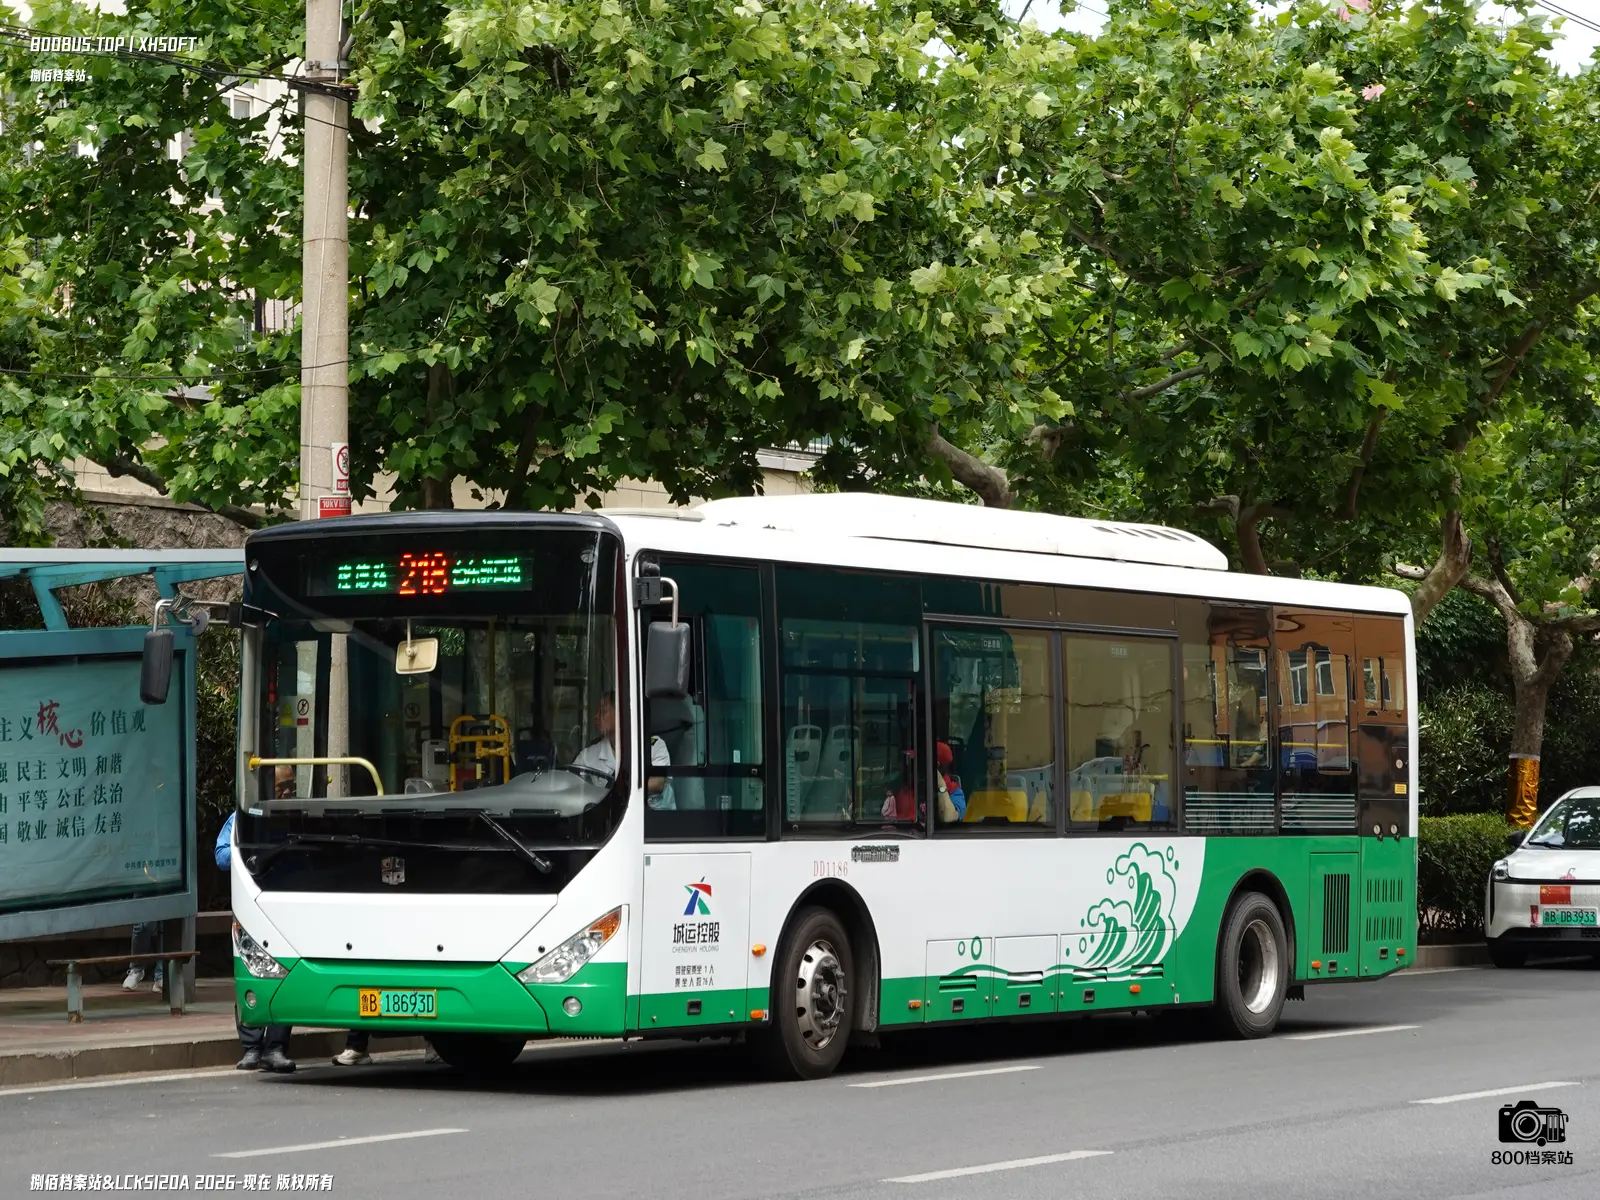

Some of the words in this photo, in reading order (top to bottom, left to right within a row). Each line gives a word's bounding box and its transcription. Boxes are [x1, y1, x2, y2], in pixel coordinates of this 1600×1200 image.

[399, 552, 448, 594] 218
[17, 759, 47, 783] 民主
[56, 756, 87, 780] 文明
[95, 752, 122, 777] 和谐
[17, 789, 48, 813] 平等
[56, 785, 85, 809] 公正
[94, 782, 123, 807] 法治
[17, 820, 47, 843] 敬业
[56, 815, 85, 839] 诚信
[95, 811, 122, 835] 友善
[813, 860, 848, 877] DD1186
[672, 921, 720, 945] 城运控股
[385, 993, 435, 1013] 18693D
